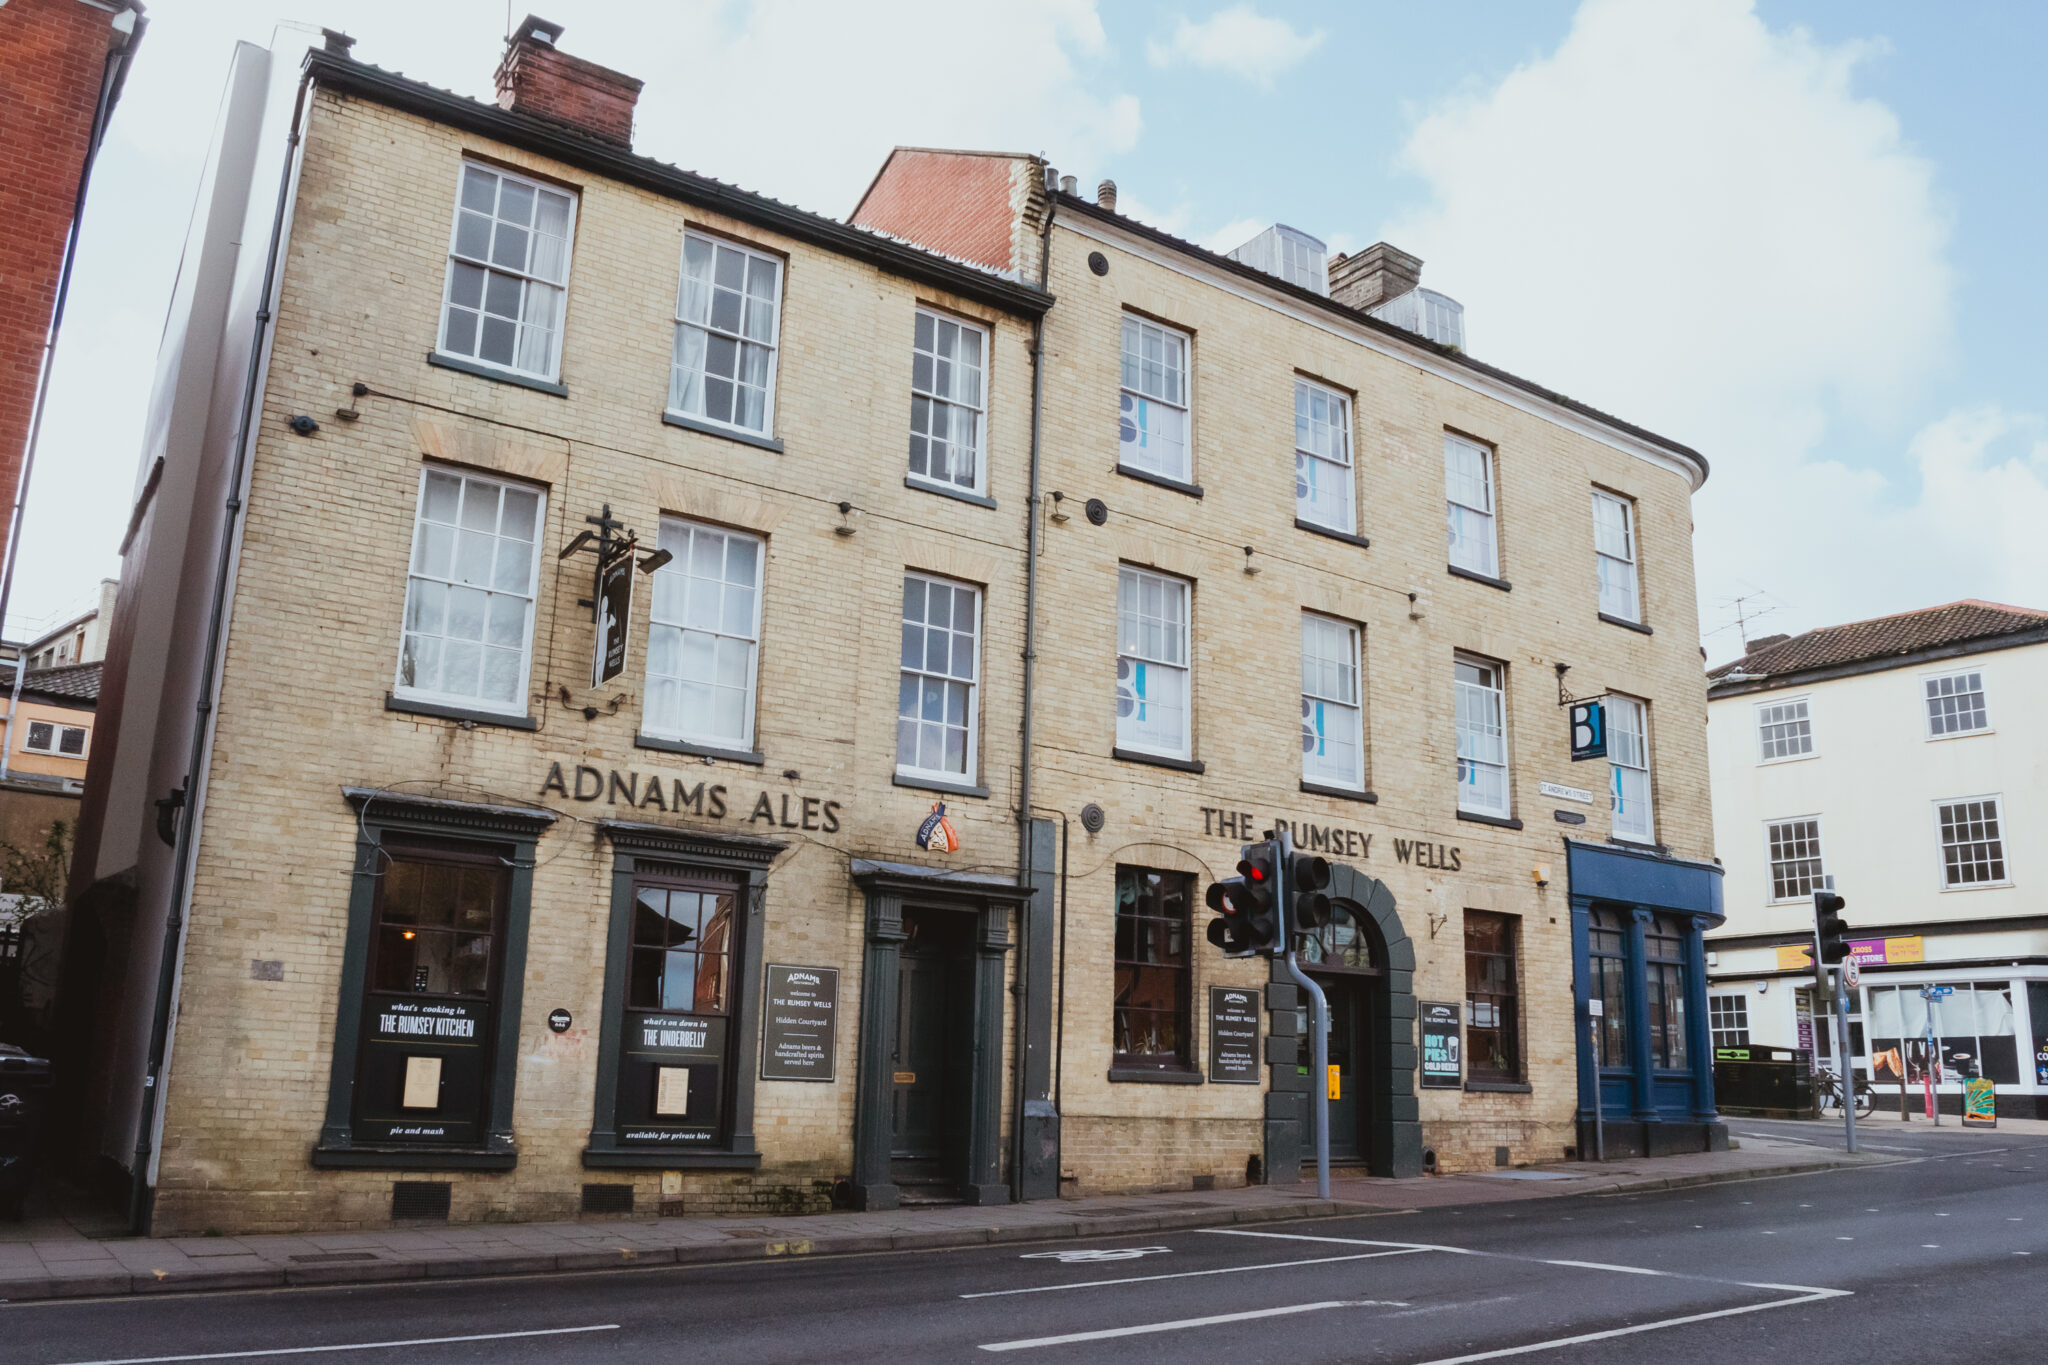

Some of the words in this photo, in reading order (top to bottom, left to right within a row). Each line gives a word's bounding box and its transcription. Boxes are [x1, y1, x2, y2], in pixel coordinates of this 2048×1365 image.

[538, 761, 728, 819] ADNAMS
[748, 791, 841, 834] ALES
[920, 815, 941, 842] ADNAMS
[1200, 807, 1253, 841] THE
[1394, 837, 1462, 872] WELLS
[1852, 946, 1873, 954] CROSS
[1862, 954, 1884, 963] STORE
[786, 972, 820, 984] ADNAMS
[787, 999, 812, 1007] RUMSEY
[813, 1001, 832, 1009] WELLS
[391, 1003, 418, 1012] what's
[422, 1006, 455, 1016] cooking
[456, 1007, 466, 1015] in
[380, 1014, 397, 1033] THE
[397, 1015, 436, 1035] RUMSEY
[435, 1018, 475, 1037] KITCHEN
[643, 1018, 666, 1026] what's
[699, 1020, 708, 1028] in
[797, 1017, 827, 1027] Courtyard
[643, 1029, 659, 1046] THE
[659, 1030, 707, 1048] UNDERBELLY
[1424, 1034, 1444, 1048] HOT
[778, 1042, 801, 1050] Adnams
[801, 1043, 816, 1051] beers
[774, 1050, 807, 1058] handcrafted
[807, 1052, 825, 1060] spirits
[1424, 1047, 1447, 1062] PIES
[1424, 1062, 1440, 1070] COLD
[389, 1126, 404, 1136] pie
[404, 1127, 422, 1135] and
[422, 1127, 445, 1135] mash
[626, 1131, 659, 1139] available
[659, 1131, 671, 1141] for
[671, 1132, 696, 1141] private
[696, 1132, 711, 1140] hire
